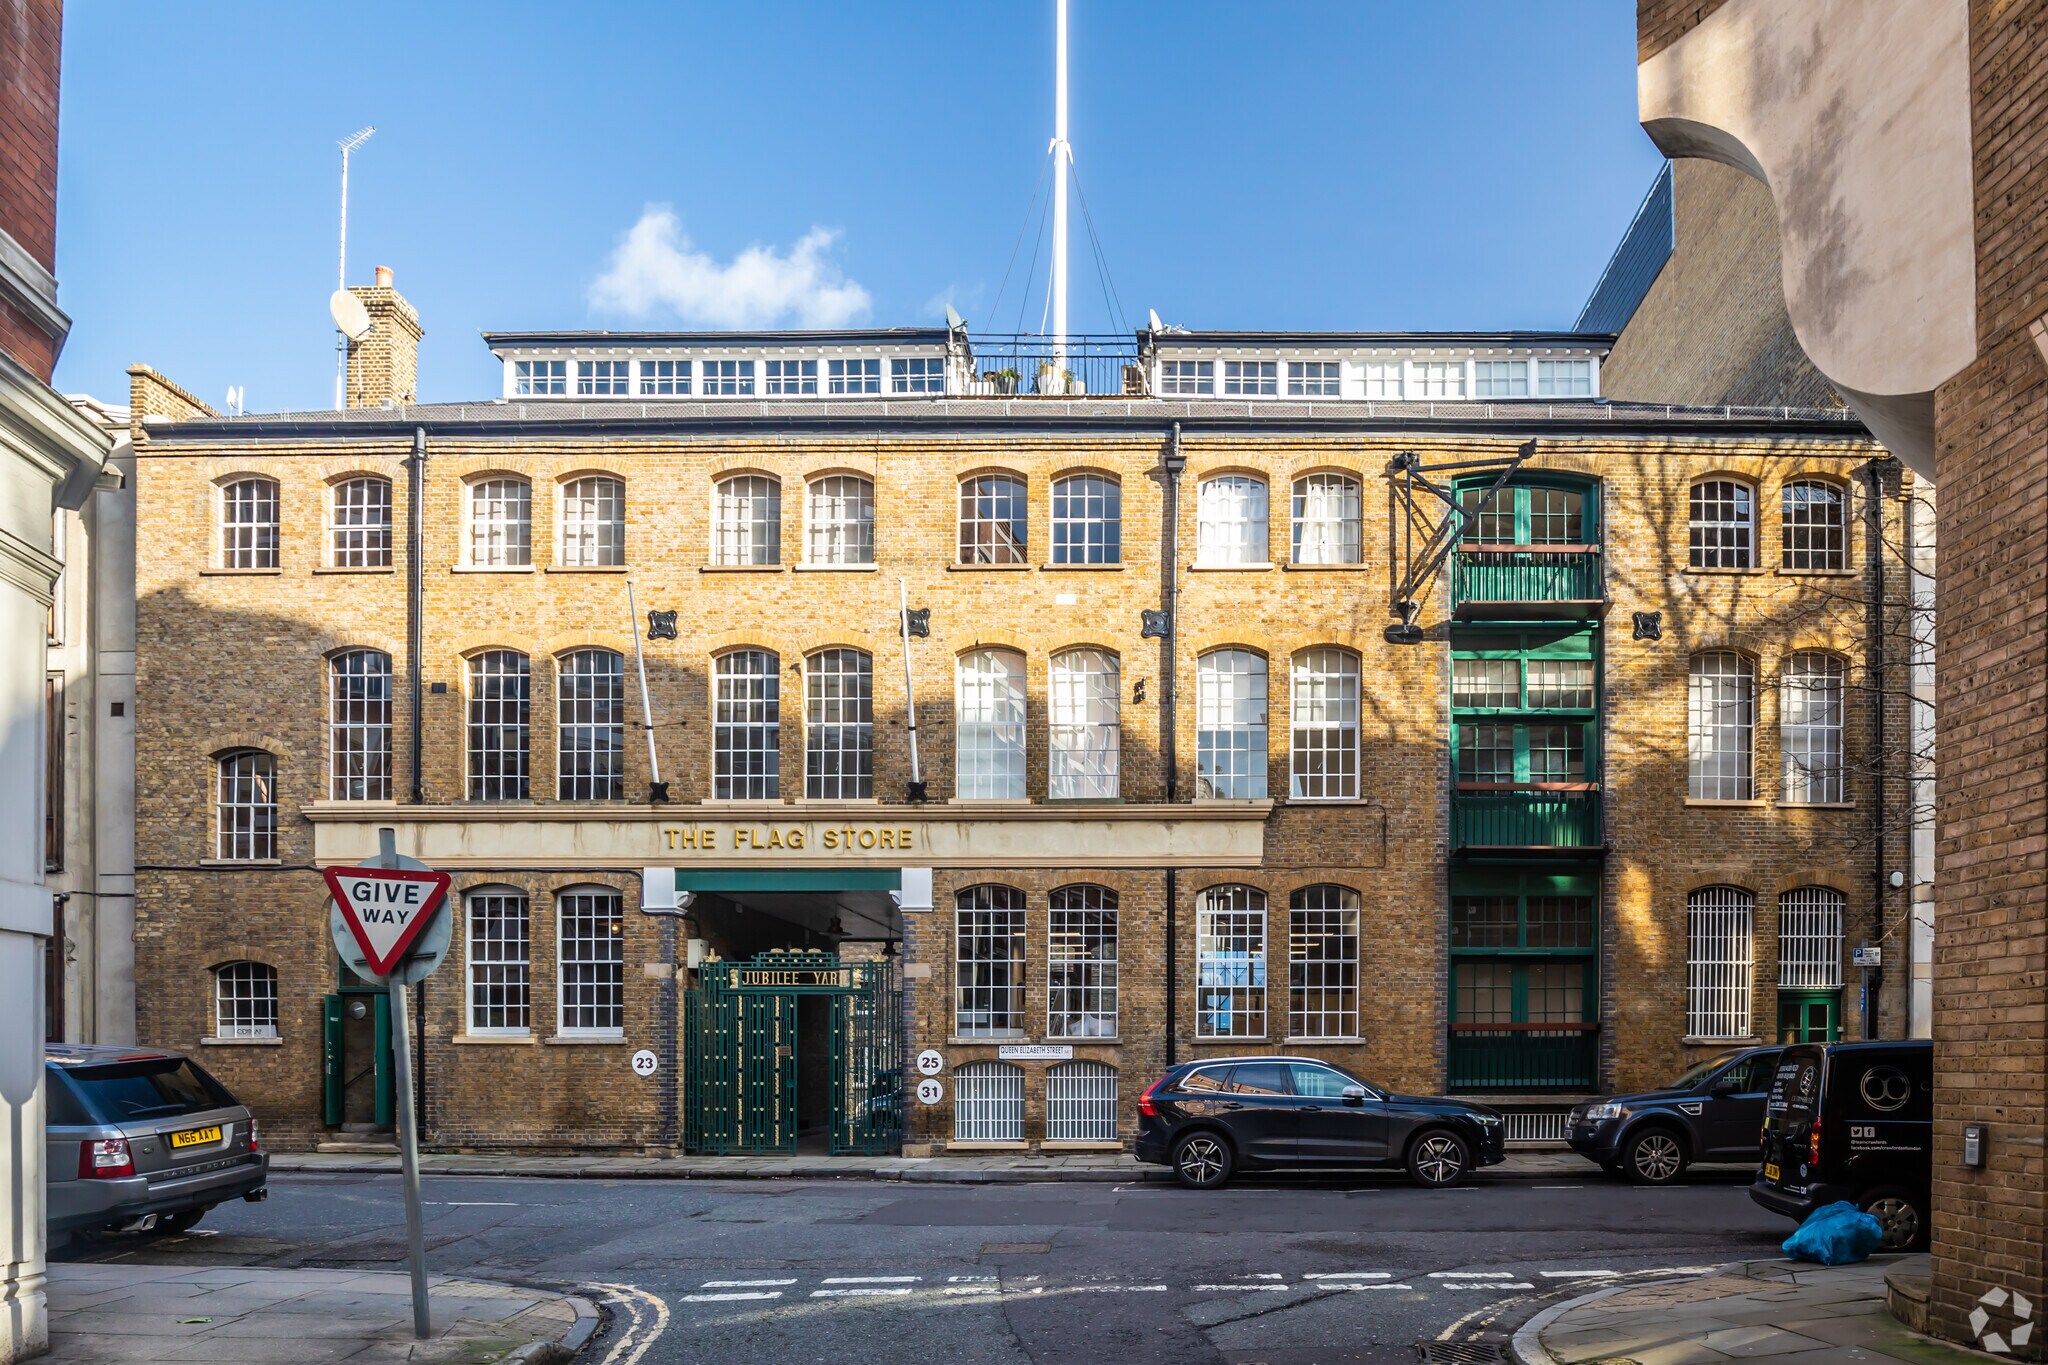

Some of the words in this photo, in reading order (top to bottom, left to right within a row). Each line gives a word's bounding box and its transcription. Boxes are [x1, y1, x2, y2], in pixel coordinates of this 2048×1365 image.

[664, 829, 716, 849] THE
[734, 829, 805, 849] FLAG
[823, 829, 913, 849] STORE
[352, 881, 420, 905] GIVE
[362, 908, 410, 925] WAY
[1855, 949, 1861, 957] P
[742, 971, 800, 985] JUBILEE
[1000, 1046, 1019, 1054] QUEEN
[1019, 1046, 1046, 1054] ELIZABETH
[1046, 1046, 1064, 1054] STREET
[636, 1057, 654, 1069] 23
[922, 1057, 939, 1068] 25
[922, 1086, 938, 1098] 31
[178, 1132, 197, 1145] N66
[198, 1129, 214, 1141] AAT
[163, 1166, 201, 1178] RANGE
[206, 1159, 237, 1169] ROVER
